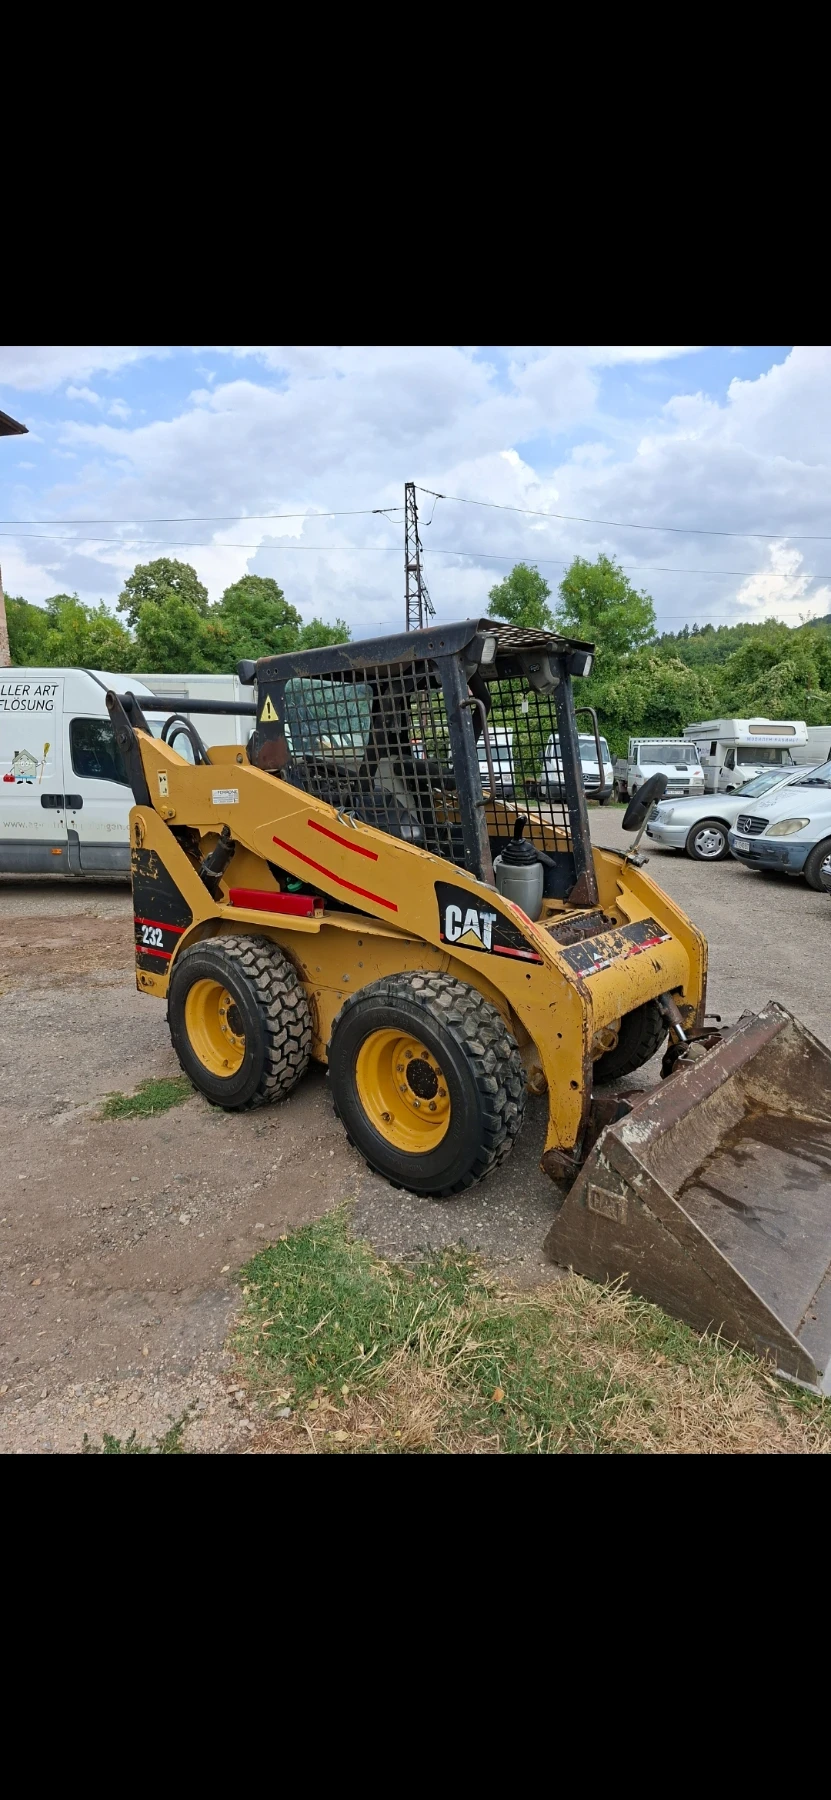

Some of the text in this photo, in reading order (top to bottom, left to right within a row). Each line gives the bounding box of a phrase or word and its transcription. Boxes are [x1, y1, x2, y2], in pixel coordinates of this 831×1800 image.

[33, 685, 59, 696] ART
[141, 925, 164, 948] 232
[444, 904, 497, 950] CAT
